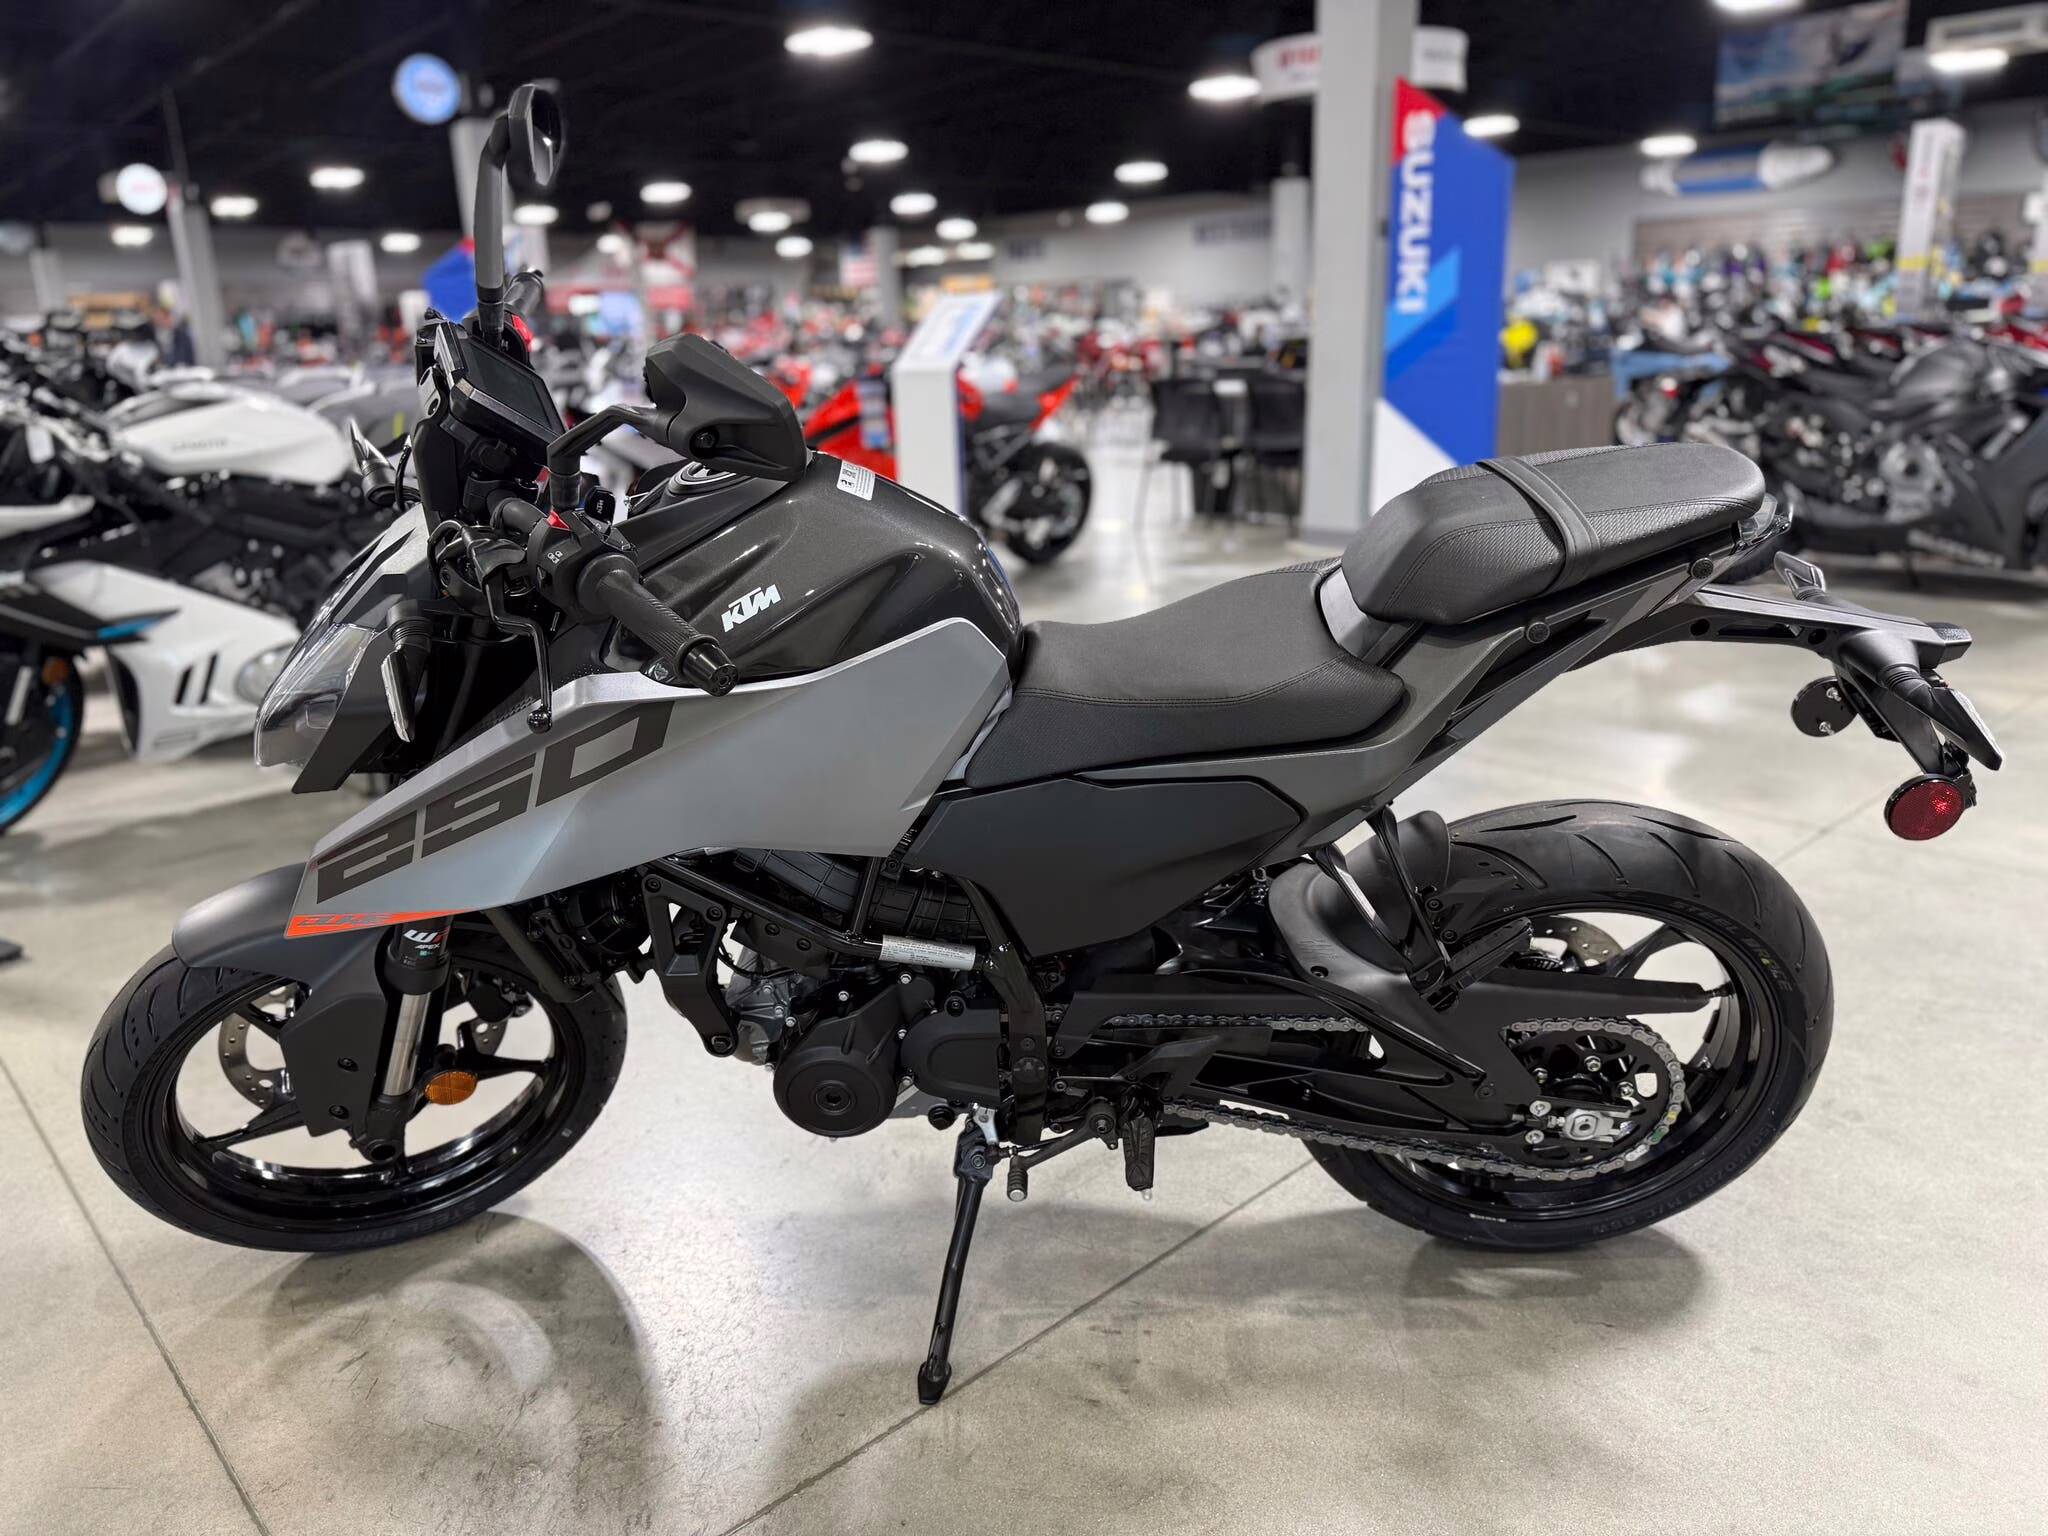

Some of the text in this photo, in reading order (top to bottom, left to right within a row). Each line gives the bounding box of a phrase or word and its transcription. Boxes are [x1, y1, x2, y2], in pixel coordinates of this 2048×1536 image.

[1396, 110, 1436, 315] SUZUKI
[721, 584, 781, 632] KTM
[317, 701, 675, 904] 250
